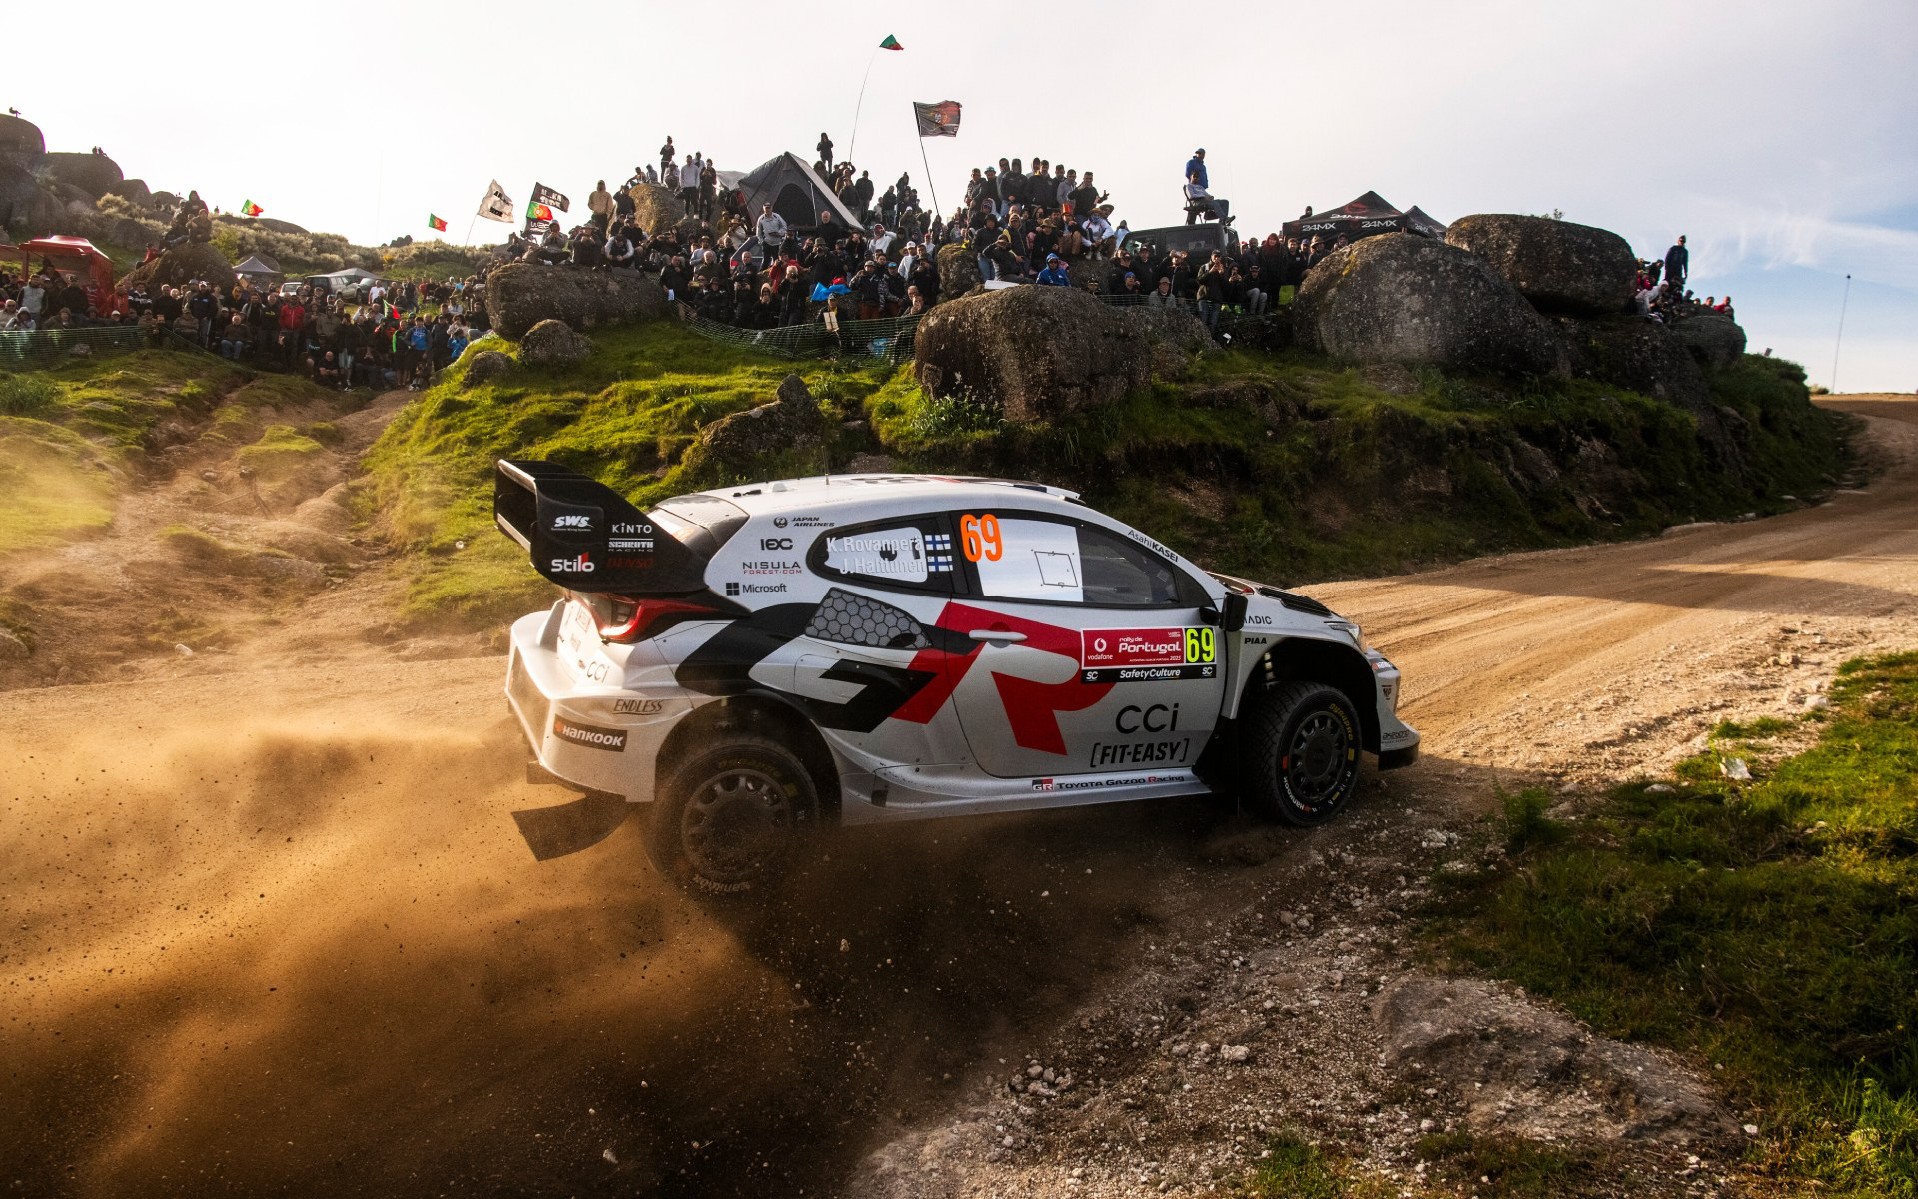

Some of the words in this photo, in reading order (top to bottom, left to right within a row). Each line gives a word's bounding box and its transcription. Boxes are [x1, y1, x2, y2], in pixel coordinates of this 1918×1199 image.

[1302, 222, 1337, 232] 24MX
[1361, 219, 1398, 228] 24MX
[554, 515, 595, 529] SWS
[960, 513, 1003, 563] 69
[551, 553, 595, 572] Stilo
[742, 561, 802, 570] NISULA
[742, 583, 788, 594] Microsoft
[1118, 641, 1182, 655] Portugal
[1185, 628, 1216, 663] 69
[1087, 653, 1114, 661] vodafone
[1086, 671, 1099, 680] SC
[1202, 667, 1213, 675] SC
[613, 699, 663, 713] ENDLESS
[1147, 775, 1184, 784] Racing
